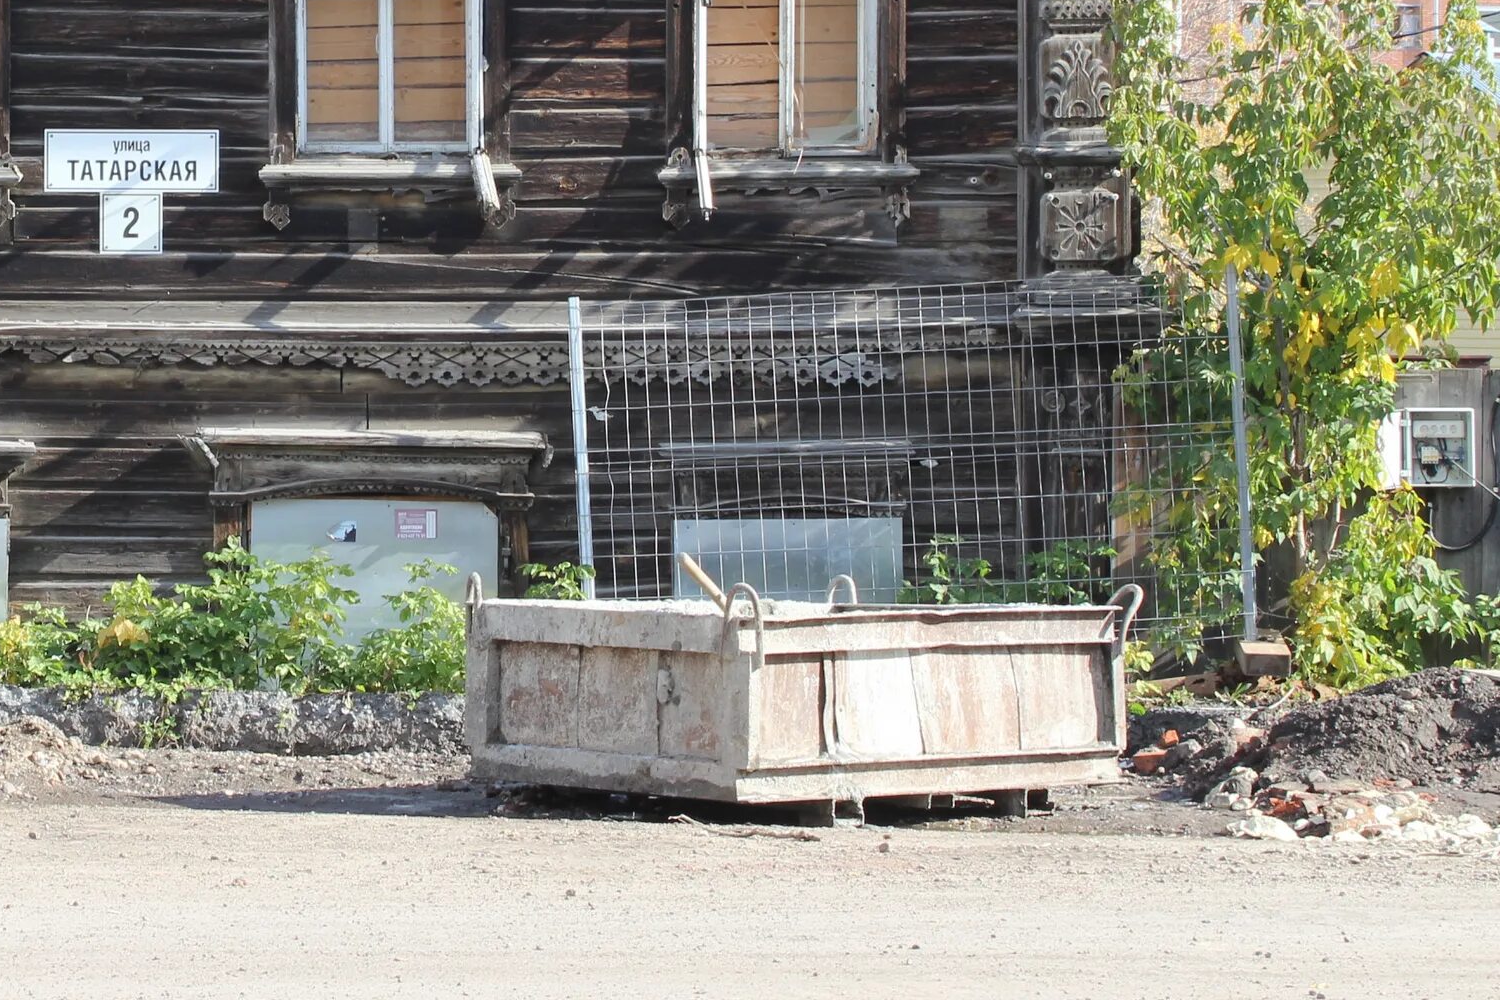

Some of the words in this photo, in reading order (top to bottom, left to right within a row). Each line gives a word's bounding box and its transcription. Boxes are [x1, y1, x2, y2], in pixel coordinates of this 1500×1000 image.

[113, 139, 150, 154] улица
[67, 160, 197, 181] ТАТАРСКАЯ
[122, 207, 140, 239] 2
